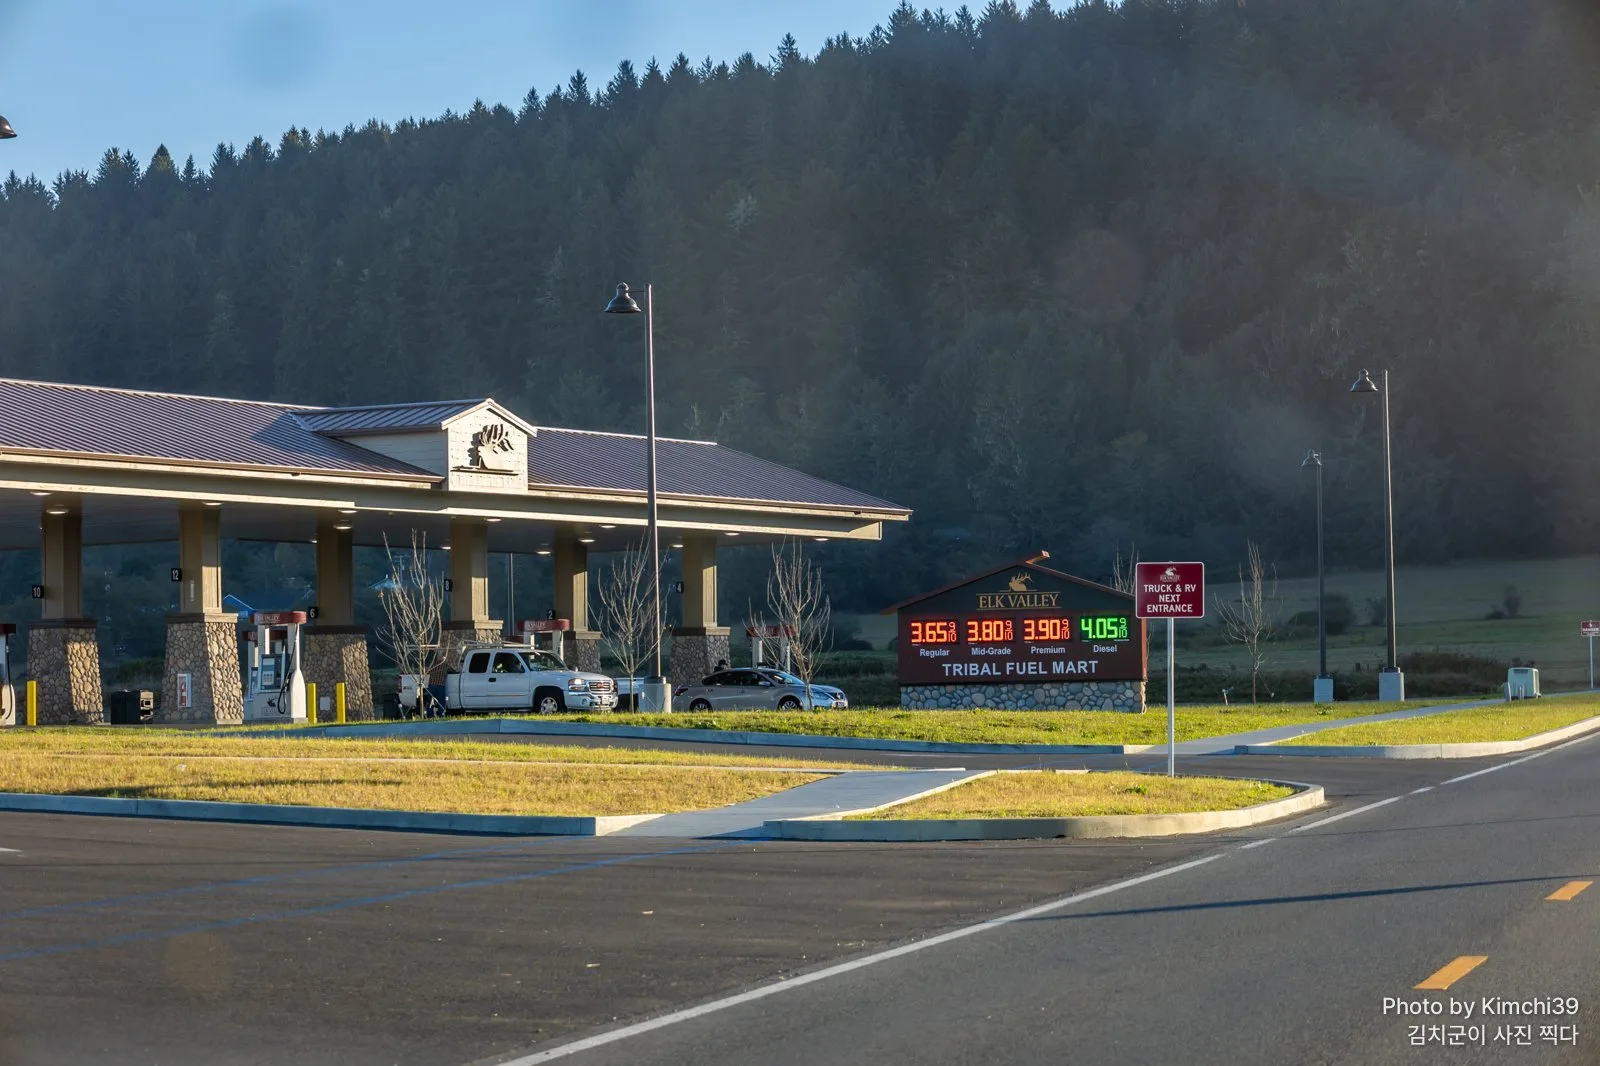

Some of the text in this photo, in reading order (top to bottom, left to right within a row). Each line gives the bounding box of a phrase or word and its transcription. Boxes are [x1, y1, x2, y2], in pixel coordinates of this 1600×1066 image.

[172, 569, 179, 580] 12
[33, 587, 41, 597] 10
[1144, 584, 1196, 592] TRUCK & RV
[979, 594, 1058, 608] ELK VALLEY
[1158, 594, 1180, 602] NEXT
[310, 608, 315, 617] 6
[1146, 604, 1192, 612] ENTRANCE
[548, 610, 553, 619] 2
[911, 622, 947, 642] 3.65
[967, 621, 1004, 641] 3.80
[1024, 619, 1060, 640] 3.90
[1081, 618, 1117, 638] 4.05
[920, 648, 950, 658] Regular
[971, 647, 1011, 655] Mid-Grade
[1031, 646, 1066, 654] Premium
[1093, 645, 1117, 653] Diesel
[942, 660, 1098, 676] TRIBAL FUEL MART
